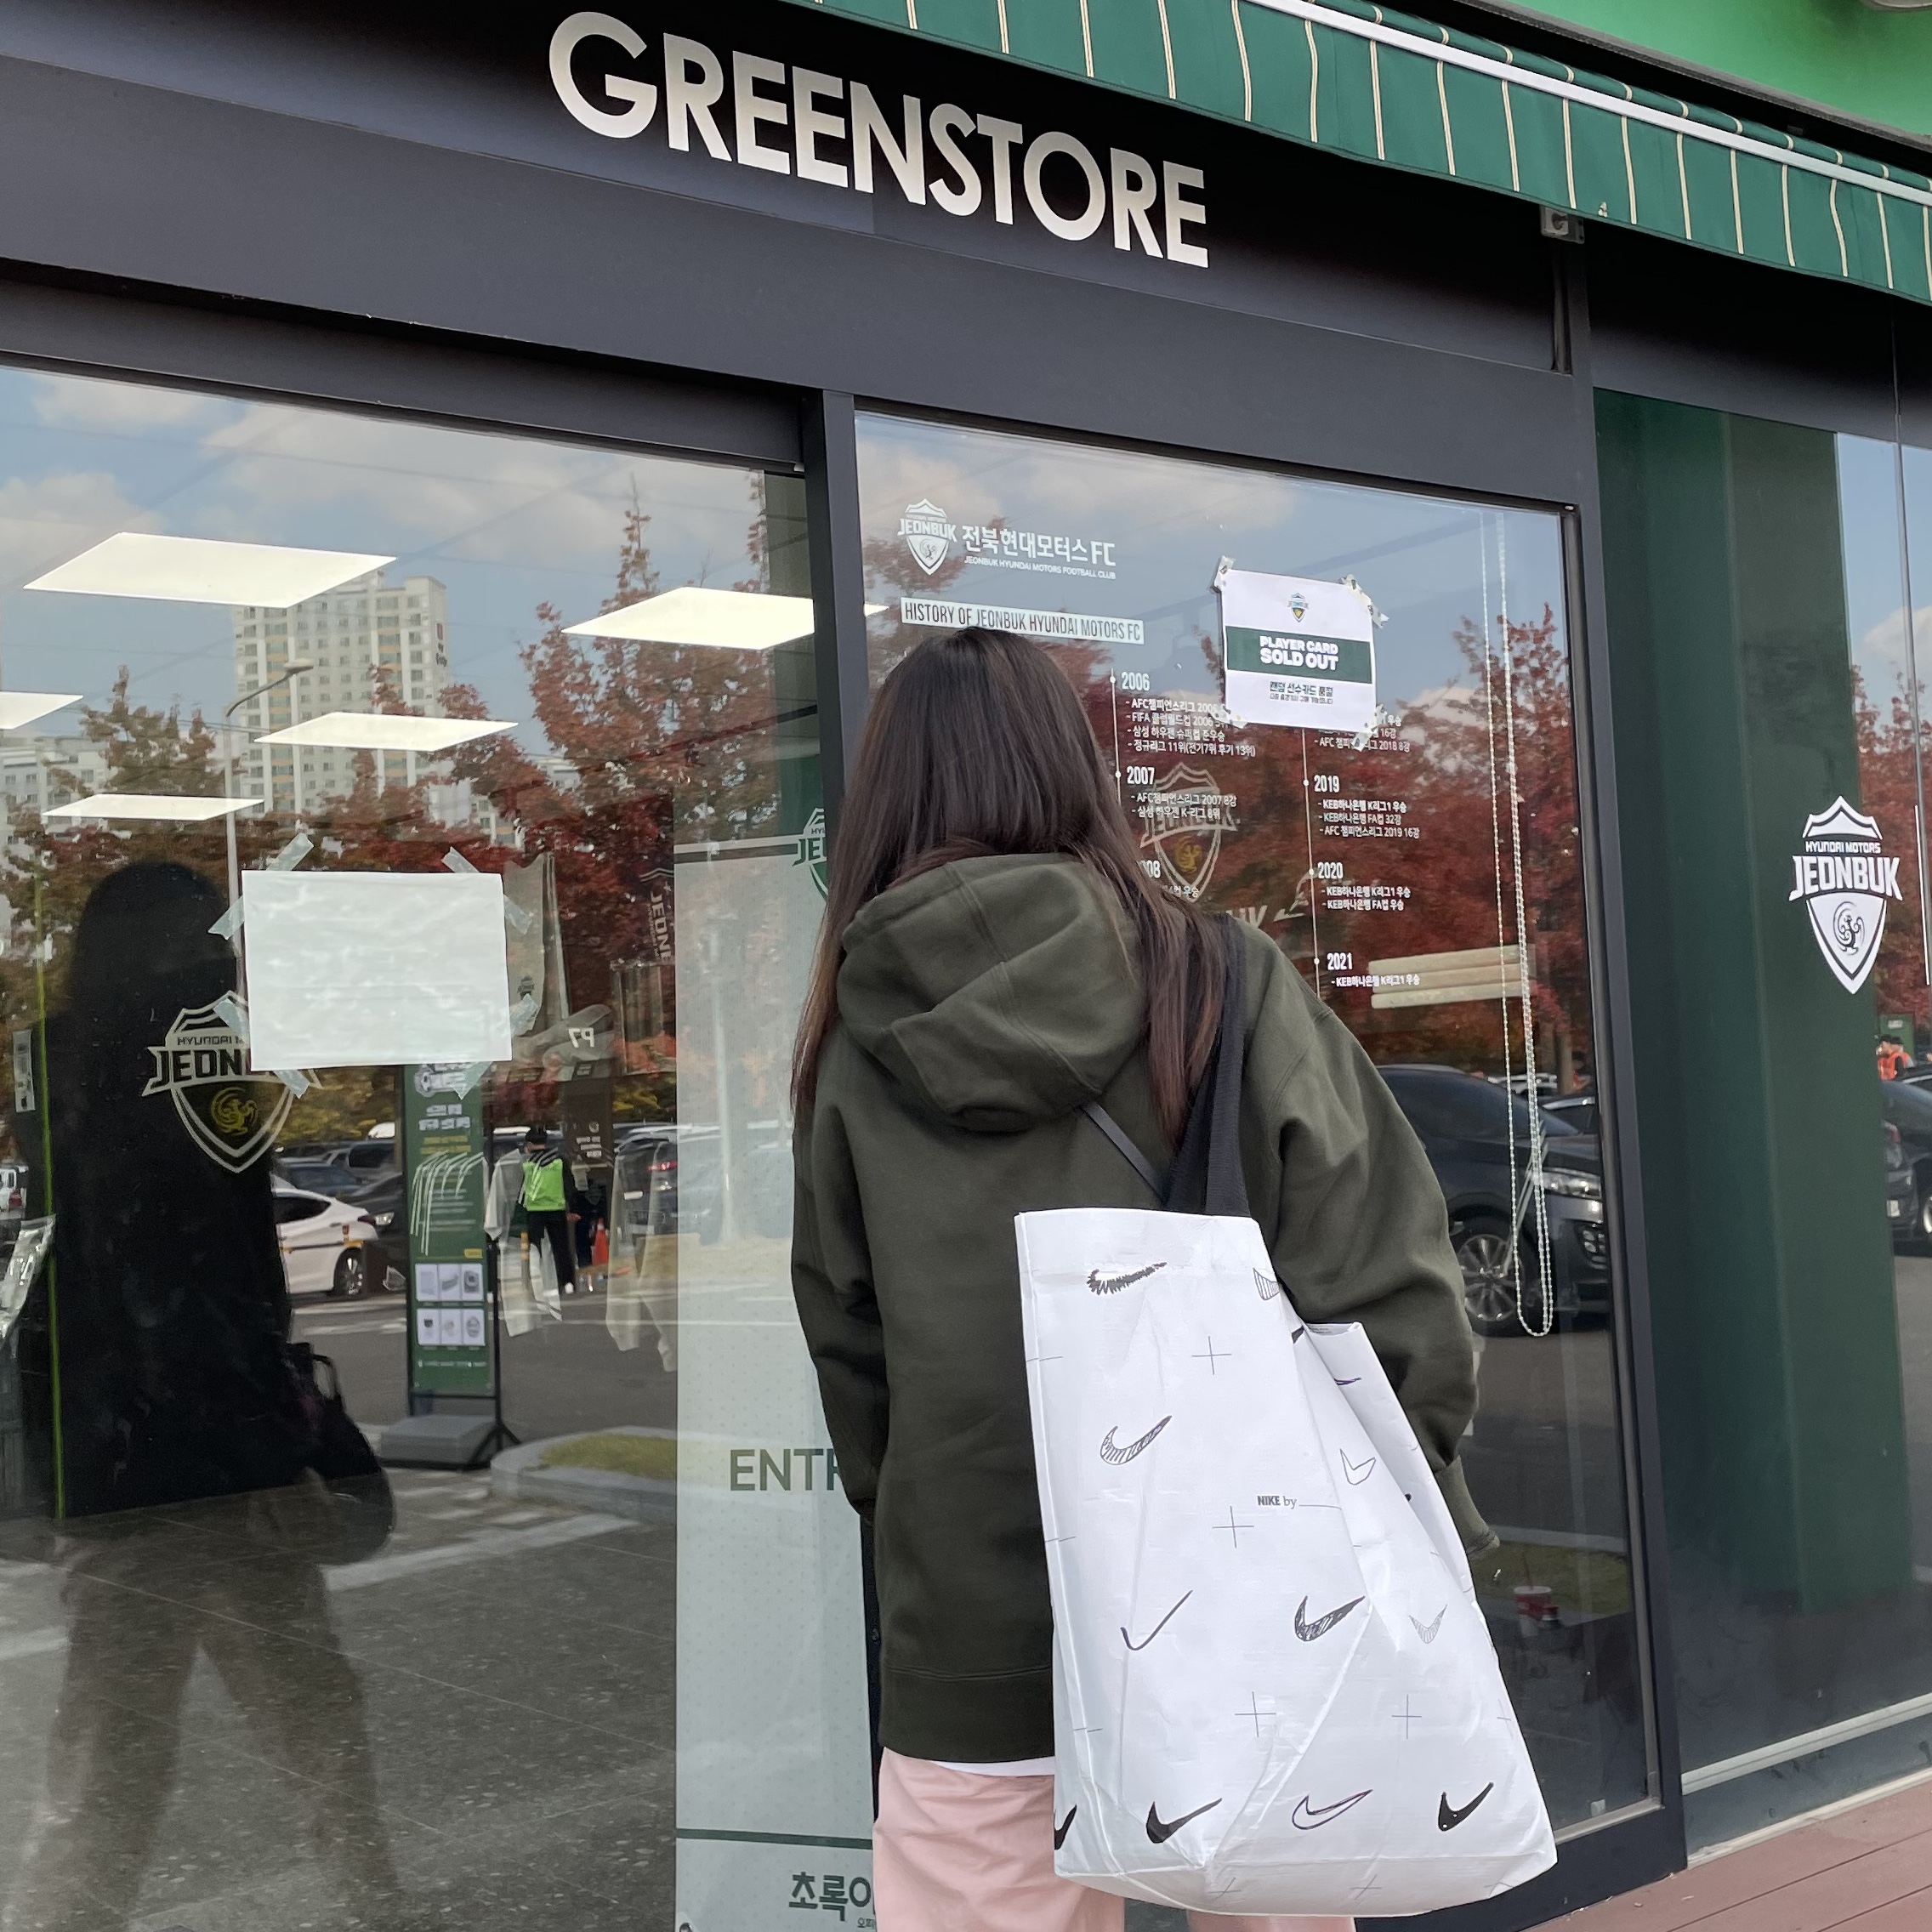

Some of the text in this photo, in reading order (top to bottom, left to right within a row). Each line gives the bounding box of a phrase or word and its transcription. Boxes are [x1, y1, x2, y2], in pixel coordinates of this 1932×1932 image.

[549, 11, 1208, 268] GREENSTORE
[897, 519, 957, 543] JEONBUK
[962, 525, 1117, 567] 전북현대모터스FC
[964, 555, 1117, 580] JEONBUK HYUNDAI MOTORS FOOTBALL CLUB
[905, 602, 1141, 641] HISTORY OF JEONBUK HYUNDAI MOTORS FC
[1259, 635, 1338, 655] PLAYER CARD
[1259, 648, 1339, 670] SOLD OUT
[1122, 671, 1150, 690] 2006
[1132, 712, 1151, 723] FIFA
[1192, 715, 1214, 728] 2006
[1319, 737, 1335, 747] AFC
[1378, 740, 1397, 751] 2018
[1127, 766, 1155, 785] 2007
[1314, 775, 1340, 793] 2019
[1202, 794, 1222, 805] 2007
[1367, 800, 1391, 811] K리그1
[1324, 825, 1340, 836] AFC
[1384, 827, 1403, 838] 2019
[1404, 827, 1420, 839] 16강
[1805, 840, 1881, 854] HYUNDAI MOTORS
[1317, 861, 1344, 879] 2020
[1788, 855, 1903, 901] JEONBUK
[1371, 885, 1395, 897] K리그1
[1327, 952, 1353, 970] 2021
[177, 1035, 232, 1046] HYUNDAI
[150, 1048, 252, 1090] JEON
[1257, 1495, 1298, 1510] NIKE by
